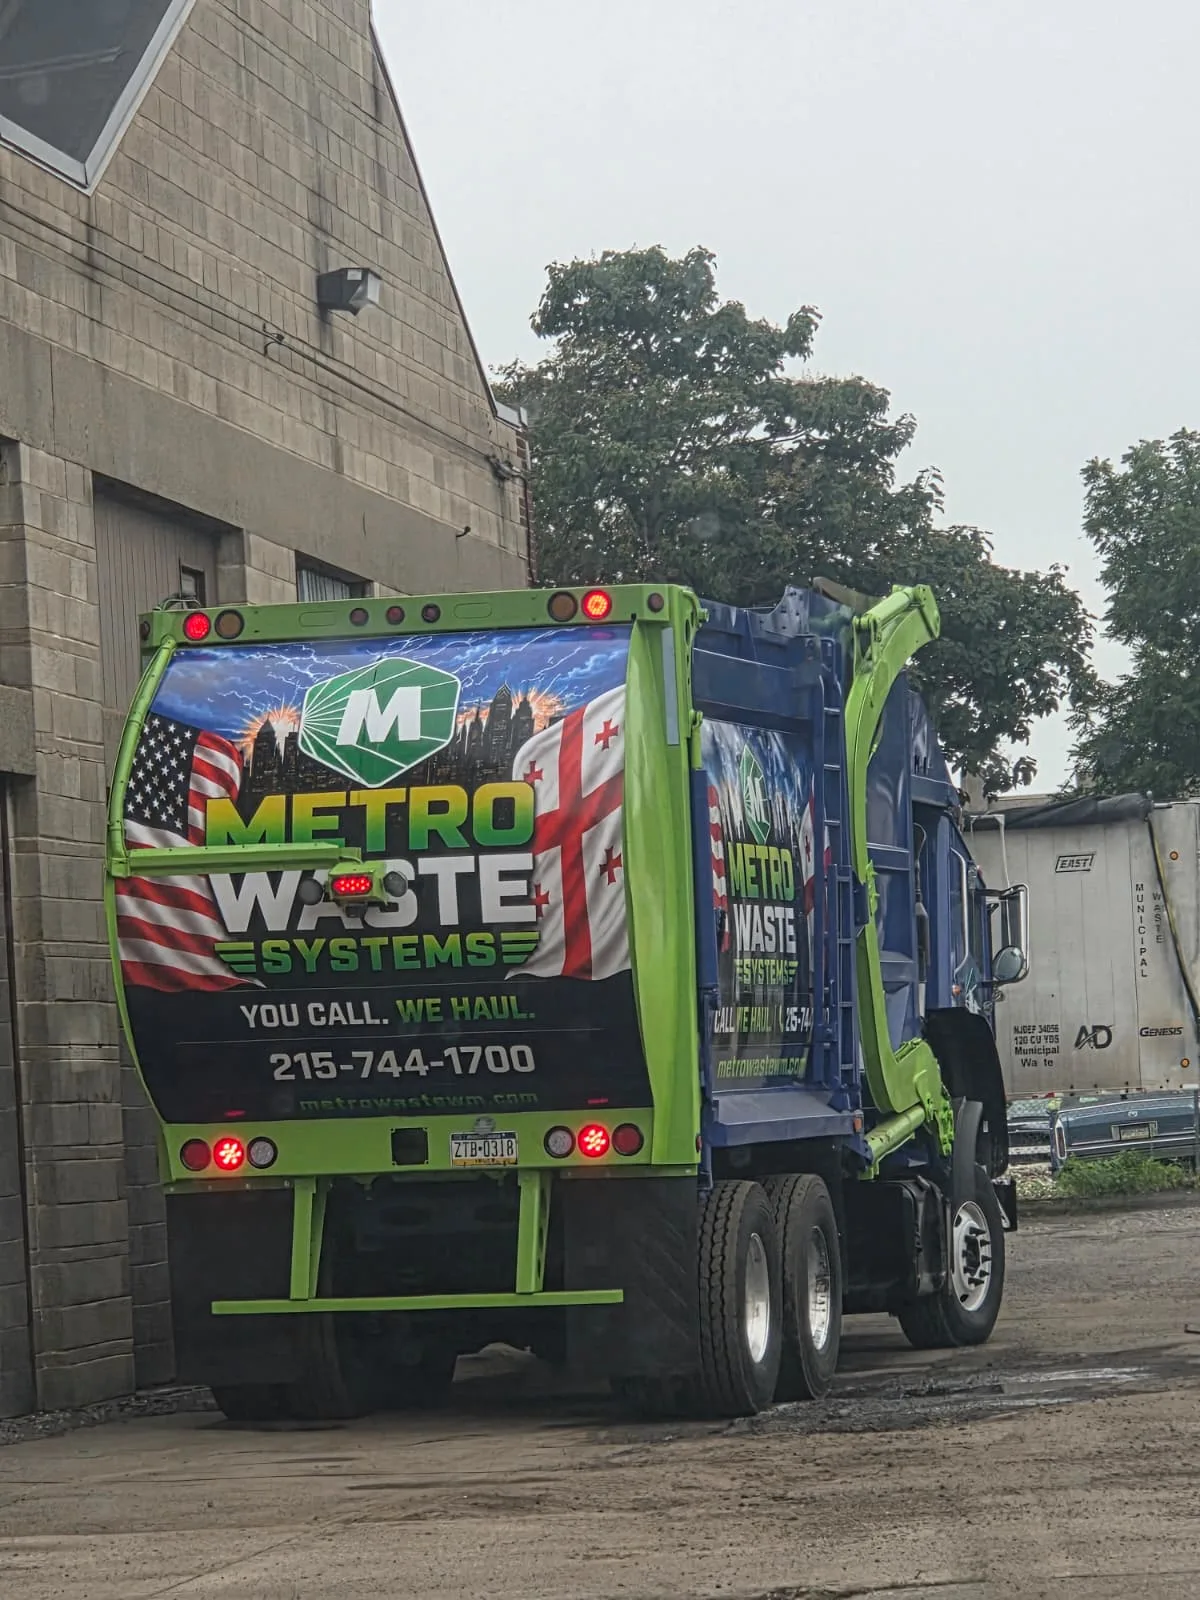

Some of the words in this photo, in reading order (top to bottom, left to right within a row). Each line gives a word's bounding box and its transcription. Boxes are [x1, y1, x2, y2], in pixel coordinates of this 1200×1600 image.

[336, 686, 421, 745] M
[206, 782, 535, 852] METRO
[728, 841, 795, 901] METRO
[1059, 858, 1090, 869] EAST
[733, 903, 797, 953] WASTE
[1135, 883, 1148, 978] MUNICIPAL
[261, 932, 497, 973] SYSTEMS
[743, 959, 790, 985] SYSTEMS
[240, 1003, 299, 1028] YOU
[308, 1001, 389, 1026] CALL.
[396, 998, 444, 1023] WE
[450, 996, 535, 1021] HAUL.
[1014, 1046, 1060, 1056] Municipal
[1015, 1036, 1029, 1045] 120
[1030, 1035, 1042, 1044] CU
[1044, 1034, 1060, 1044] YDS
[269, 1045, 536, 1081] 215-744-1700
